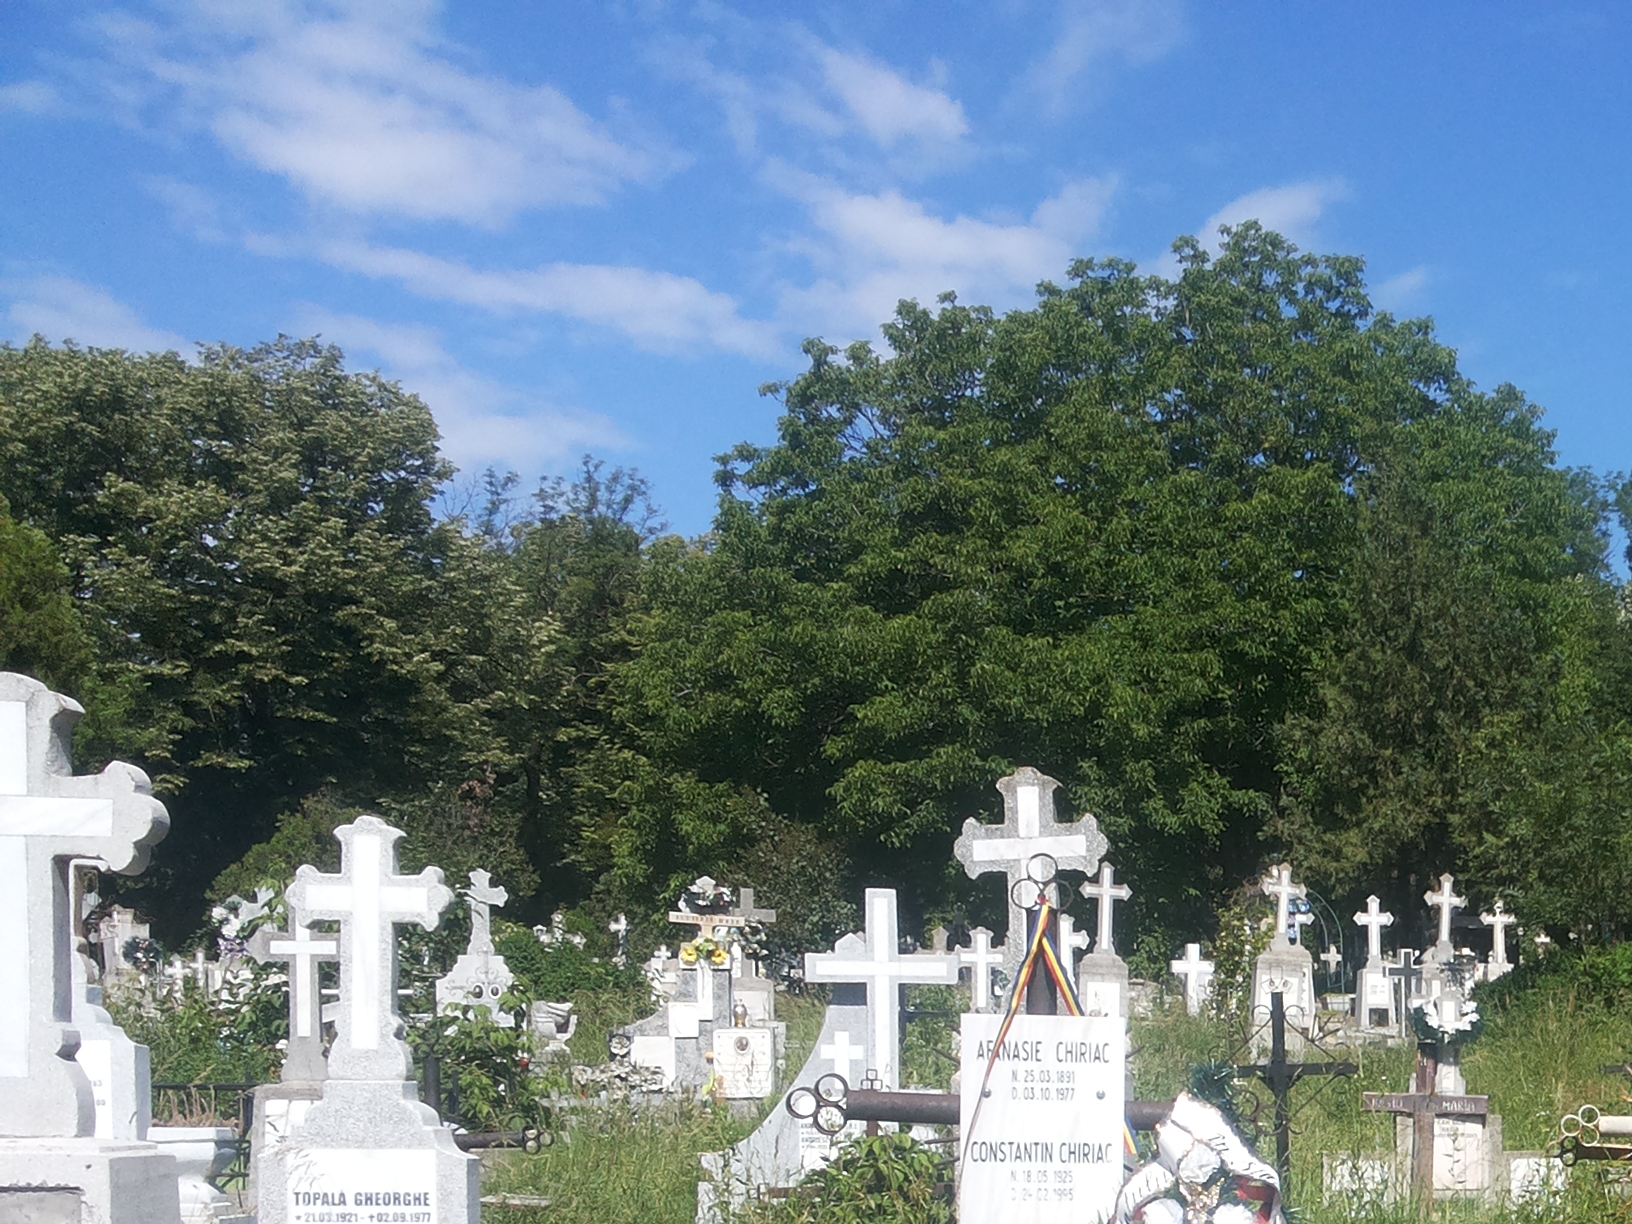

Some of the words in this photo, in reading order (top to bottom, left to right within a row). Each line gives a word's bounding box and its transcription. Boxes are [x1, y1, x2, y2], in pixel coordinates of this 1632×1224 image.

[976, 1040, 1043, 1063] AFANASIE
[1056, 1041, 1110, 1064] CHIRIAC
[970, 1141, 1053, 1164] CONSTANTIN
[1059, 1142, 1113, 1164] CHIRIAC
[354, 1191, 431, 1207] GHEORGHE
